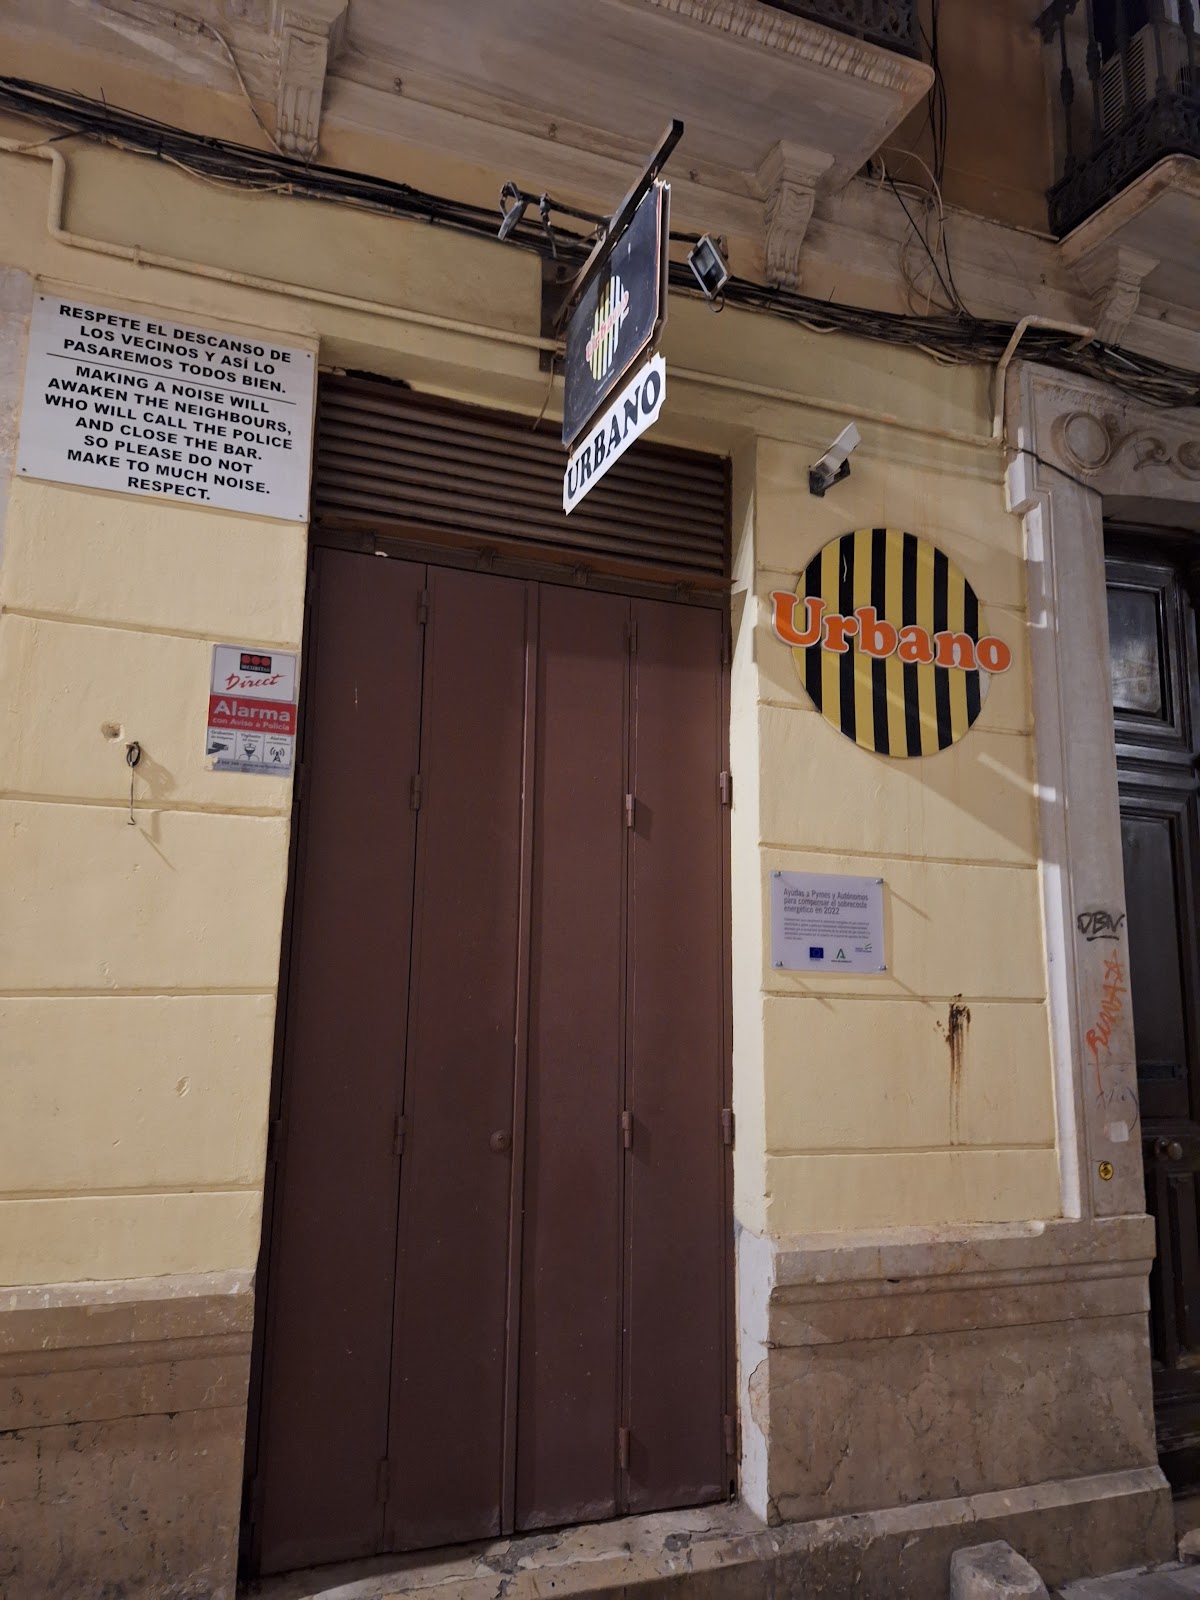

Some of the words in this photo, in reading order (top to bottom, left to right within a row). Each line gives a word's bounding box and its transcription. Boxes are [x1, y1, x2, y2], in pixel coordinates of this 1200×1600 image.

[59, 304, 141, 331] RESPETE
[147, 323, 167, 337] EL
[173, 328, 265, 357] DESCANSO
[270, 349, 291, 363] DE
[80, 325, 115, 341] LOS
[121, 333, 198, 359] VECINOS
[205, 351, 216, 362] Y
[220, 355, 248, 369] ASÍ
[254, 361, 275, 375] LO
[64, 338, 173, 369] PASAREMOS
[179, 362, 236, 382] TODOS
[242, 375, 286, 393] BIEN.
[48, 378, 127, 402] AWAKEN
[134, 393, 168, 409] THE
[175, 401, 291, 435] NEIGHBOURS,
[76, 366, 148, 389] MAKING
[154, 382, 166, 393] A
[172, 384, 224, 404] NOISE
[230, 396, 269, 413] WILL
[45, 393, 88, 411] WHO
[94, 402, 136, 420] WILL
[143, 412, 187, 430] CALL
[193, 421, 226, 437] THE
[233, 429, 292, 450] POLICE
[75, 417, 114, 432] AND
[120, 425, 177, 444] CLOSE
[184, 436, 217, 451] THE
[224, 443, 262, 460] BAR.
[567, 370, 661, 500] URBANO
[68, 449, 120, 468] MAKE
[126, 459, 149, 472] TO
[156, 464, 207, 483] MUCH
[214, 474, 270, 494] NOISE.
[84, 435, 108, 448] SO
[115, 440, 182, 462] PLEASE
[189, 453, 212, 466] DO
[218, 459, 253, 474] NOT
[128, 476, 210, 500] RESPECT.
[769, 590, 1012, 673] Urbano
[225, 673, 287, 691] Direct
[241, 664, 270, 673] SECURITAS
[212, 717, 228, 725] con
[230, 718, 253, 727] Aviso
[214, 700, 291, 722] Alarma
[783, 888, 805, 898] Ayudas
[811, 890, 831, 899] Pymes
[837, 892, 869, 901] Autónomos
[783, 897, 797, 906] para
[798, 899, 830, 908] compensar
[837, 900, 867, 909] sobrecoste
[783, 906, 813, 915] energético
[823, 907, 840, 915] 2022
